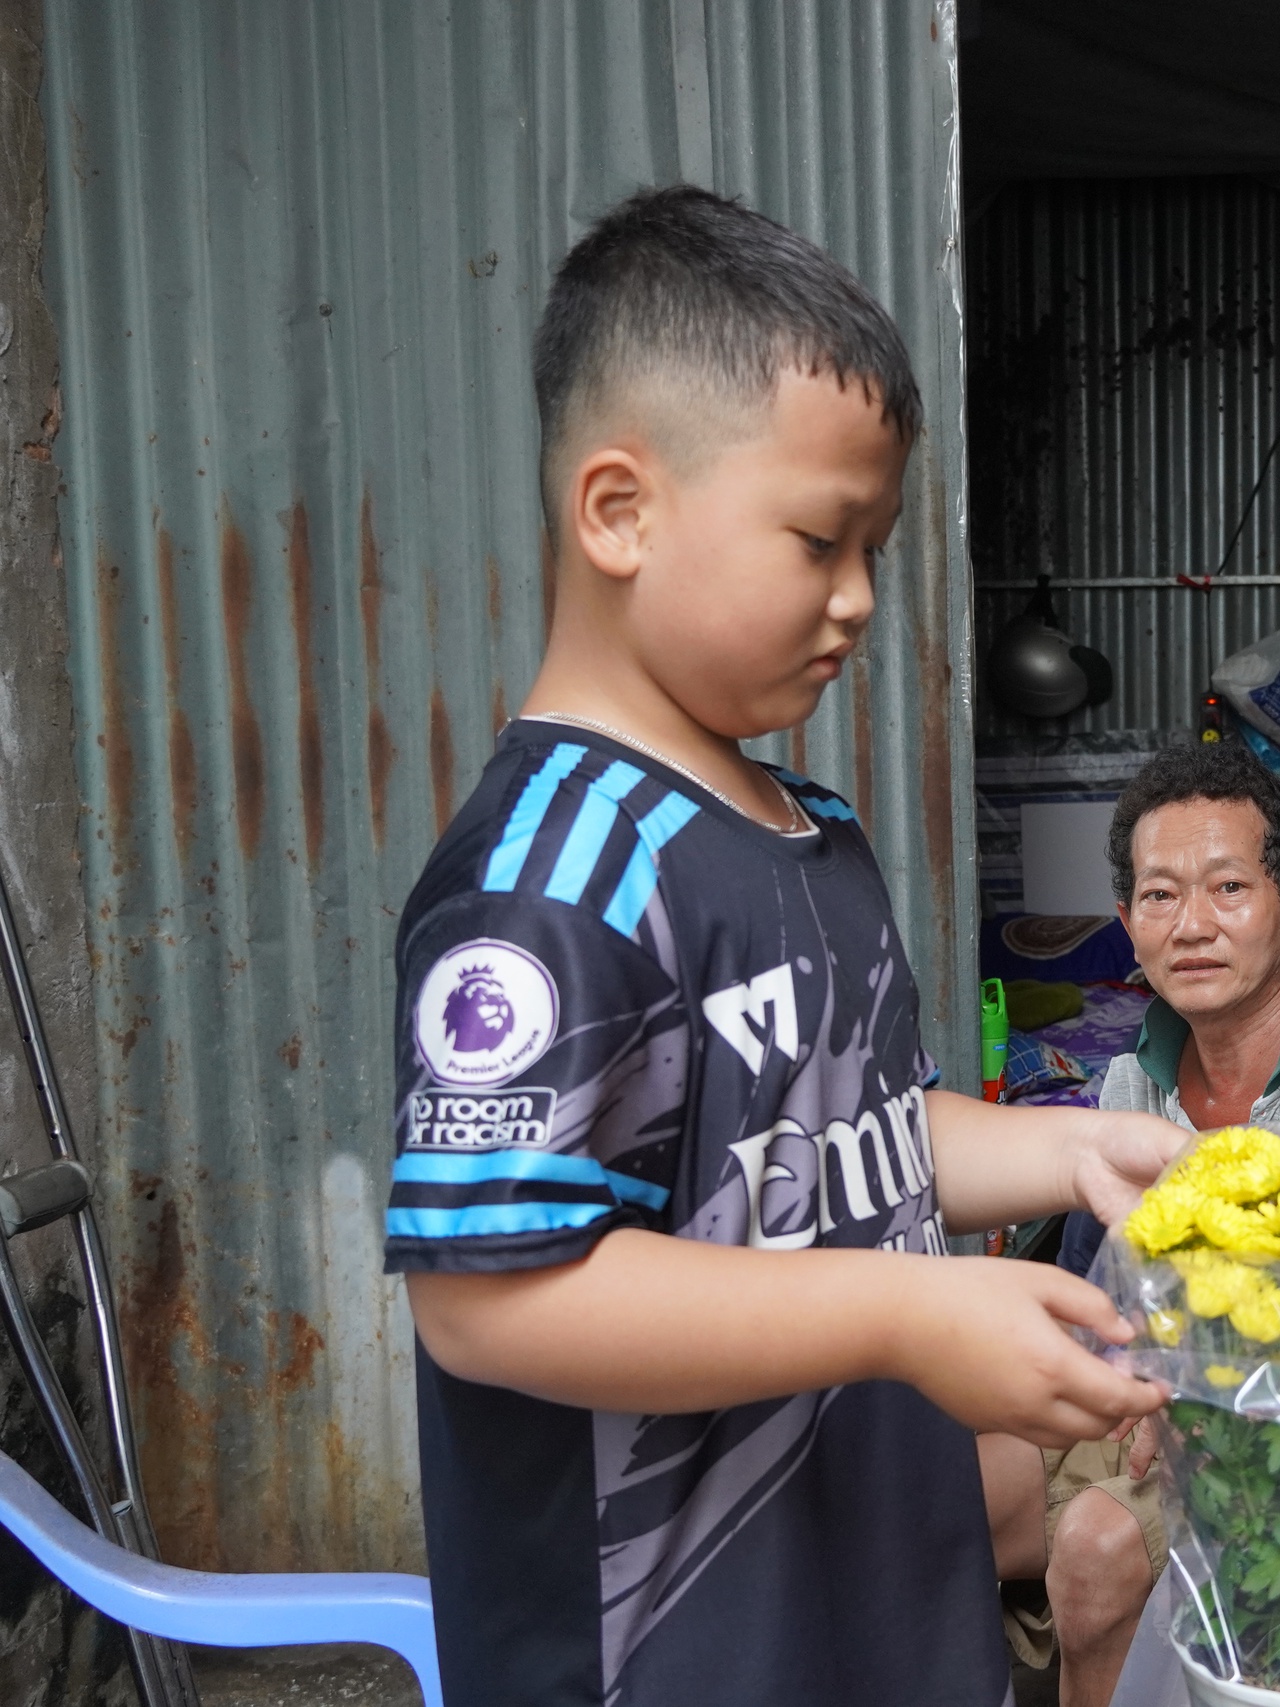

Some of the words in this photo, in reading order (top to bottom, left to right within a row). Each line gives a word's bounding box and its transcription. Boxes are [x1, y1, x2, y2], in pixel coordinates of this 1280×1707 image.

[447, 1059, 499, 1074] Premier
[502, 1029, 540, 1066] League
[437, 1095, 533, 1121] room
[432, 1119, 547, 1144] racism
